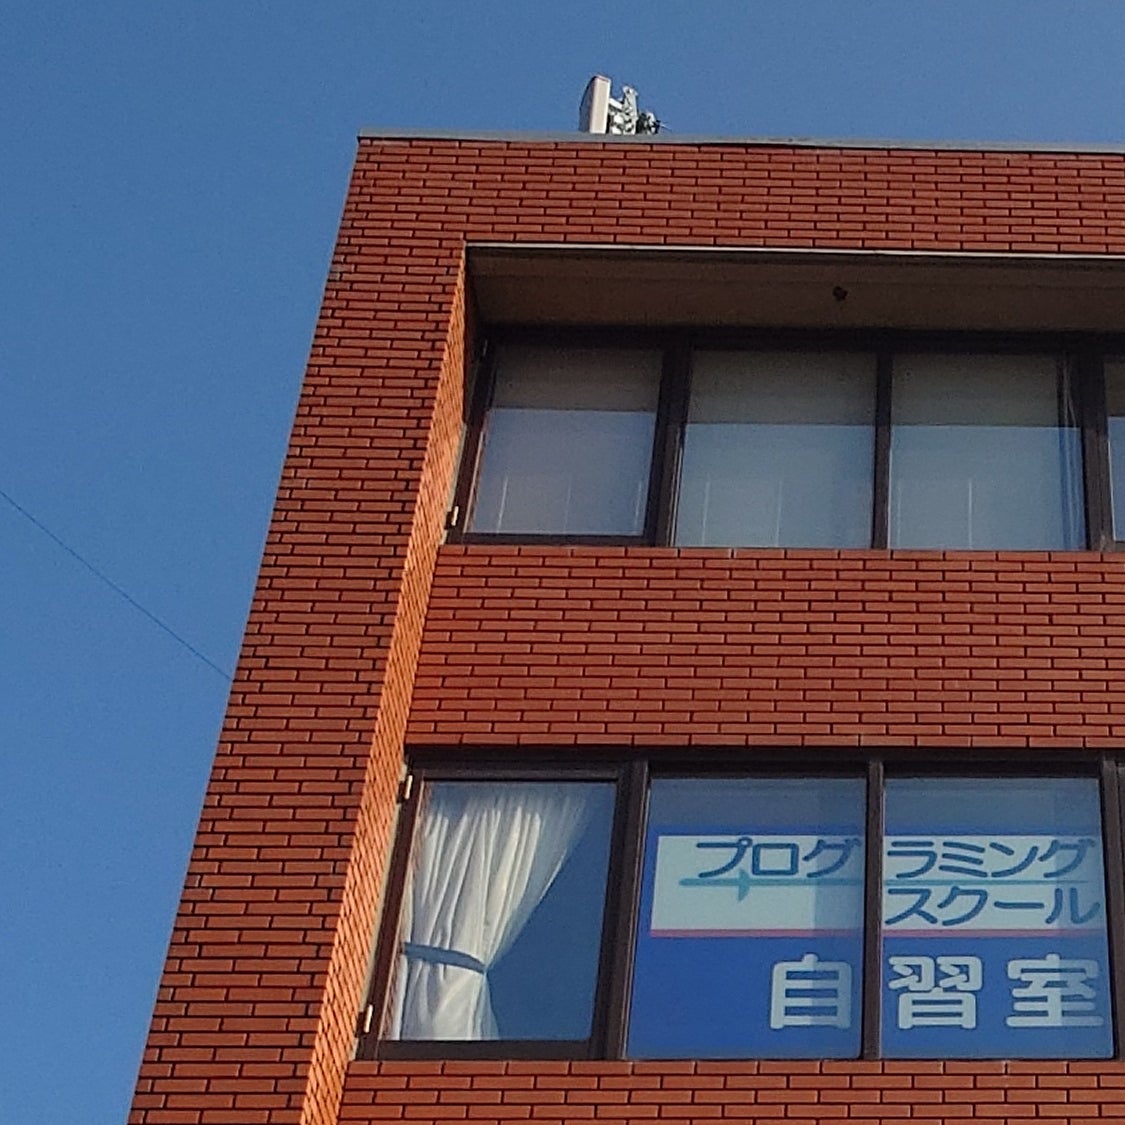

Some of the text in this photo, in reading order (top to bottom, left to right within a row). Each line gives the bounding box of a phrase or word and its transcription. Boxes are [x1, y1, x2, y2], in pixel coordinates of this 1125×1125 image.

[696, 836, 1098, 880] プログラミング
[884, 886, 1101, 927] スクール
[768, 952, 1105, 1031] 自習室
